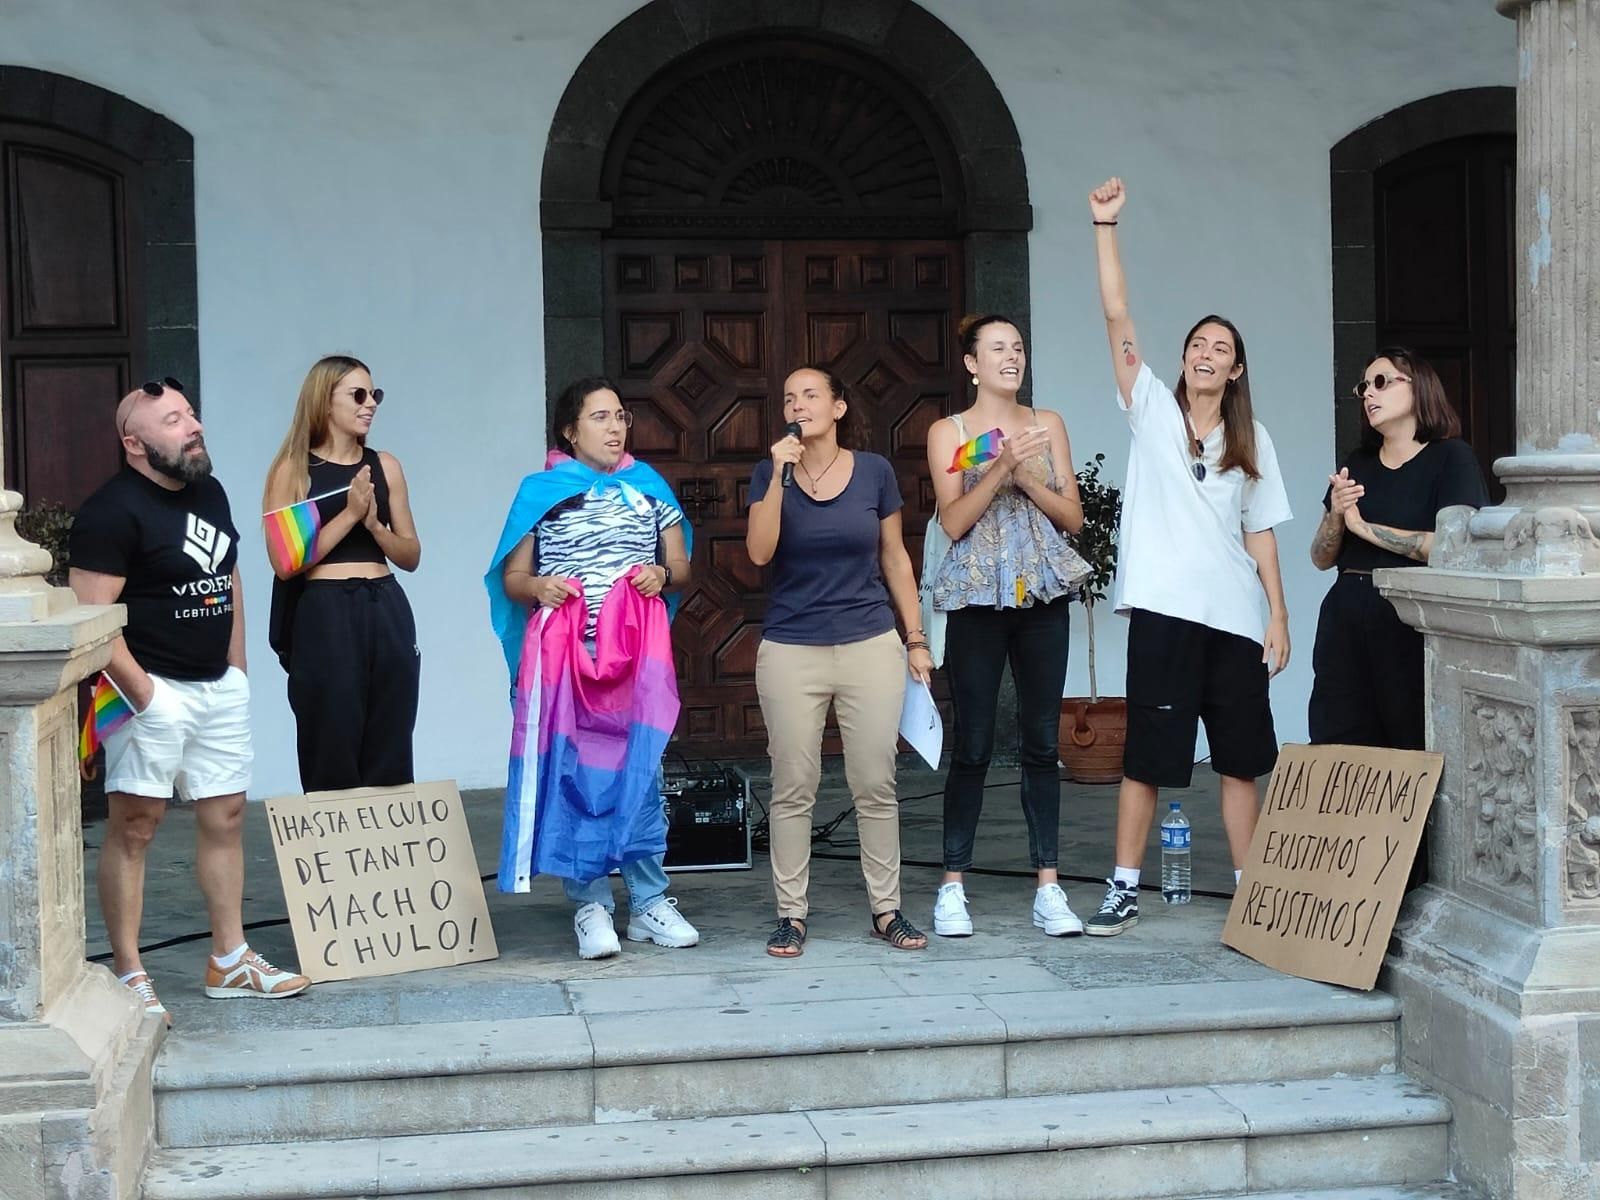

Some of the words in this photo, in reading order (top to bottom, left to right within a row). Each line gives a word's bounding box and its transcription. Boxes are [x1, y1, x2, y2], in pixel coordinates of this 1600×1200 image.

[175, 607, 209, 619] LGBTI
[212, 606, 223, 616] LA
[1267, 759, 1317, 816] ¡LAS
[1318, 761, 1428, 823] LESBIANAS
[269, 807, 350, 846] ¡HASTA
[357, 806, 383, 830] EL
[387, 799, 449, 829] CULO
[295, 851, 334, 885] DE
[345, 837, 447, 877] TANTO
[1263, 831, 1366, 878] EXISTIMOS
[1374, 835, 1399, 885] Y
[306, 880, 452, 932] MACHO
[1241, 880, 1381, 957] RESISTIMOS!
[323, 917, 478, 967] CHULO!
